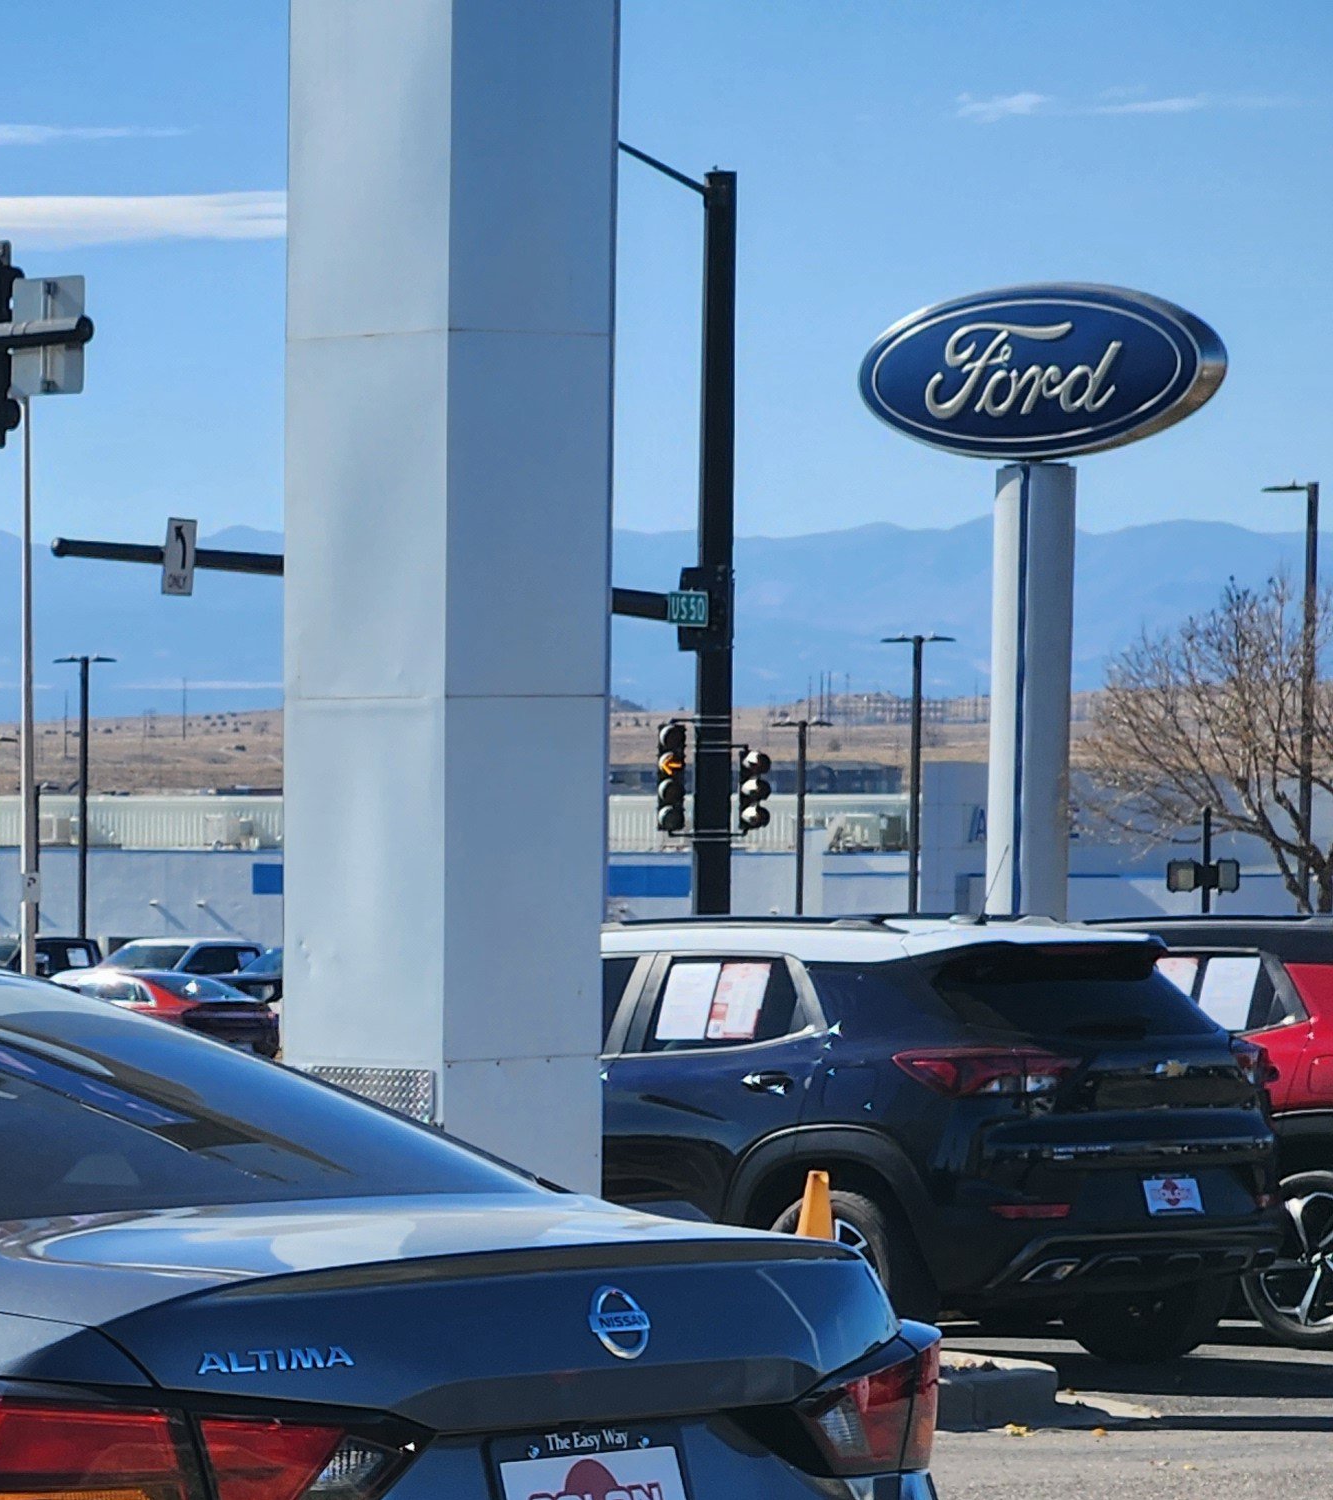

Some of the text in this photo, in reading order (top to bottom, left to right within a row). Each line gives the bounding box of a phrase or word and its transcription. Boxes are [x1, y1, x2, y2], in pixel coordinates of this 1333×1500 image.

[925, 320, 1123, 420] Ford
[671, 597, 705, 620] US 50
[598, 1314, 648, 1331] NISSAN
[197, 1345, 356, 1375] ALTIMA
[545, 1429, 630, 1452] The Easy Way
